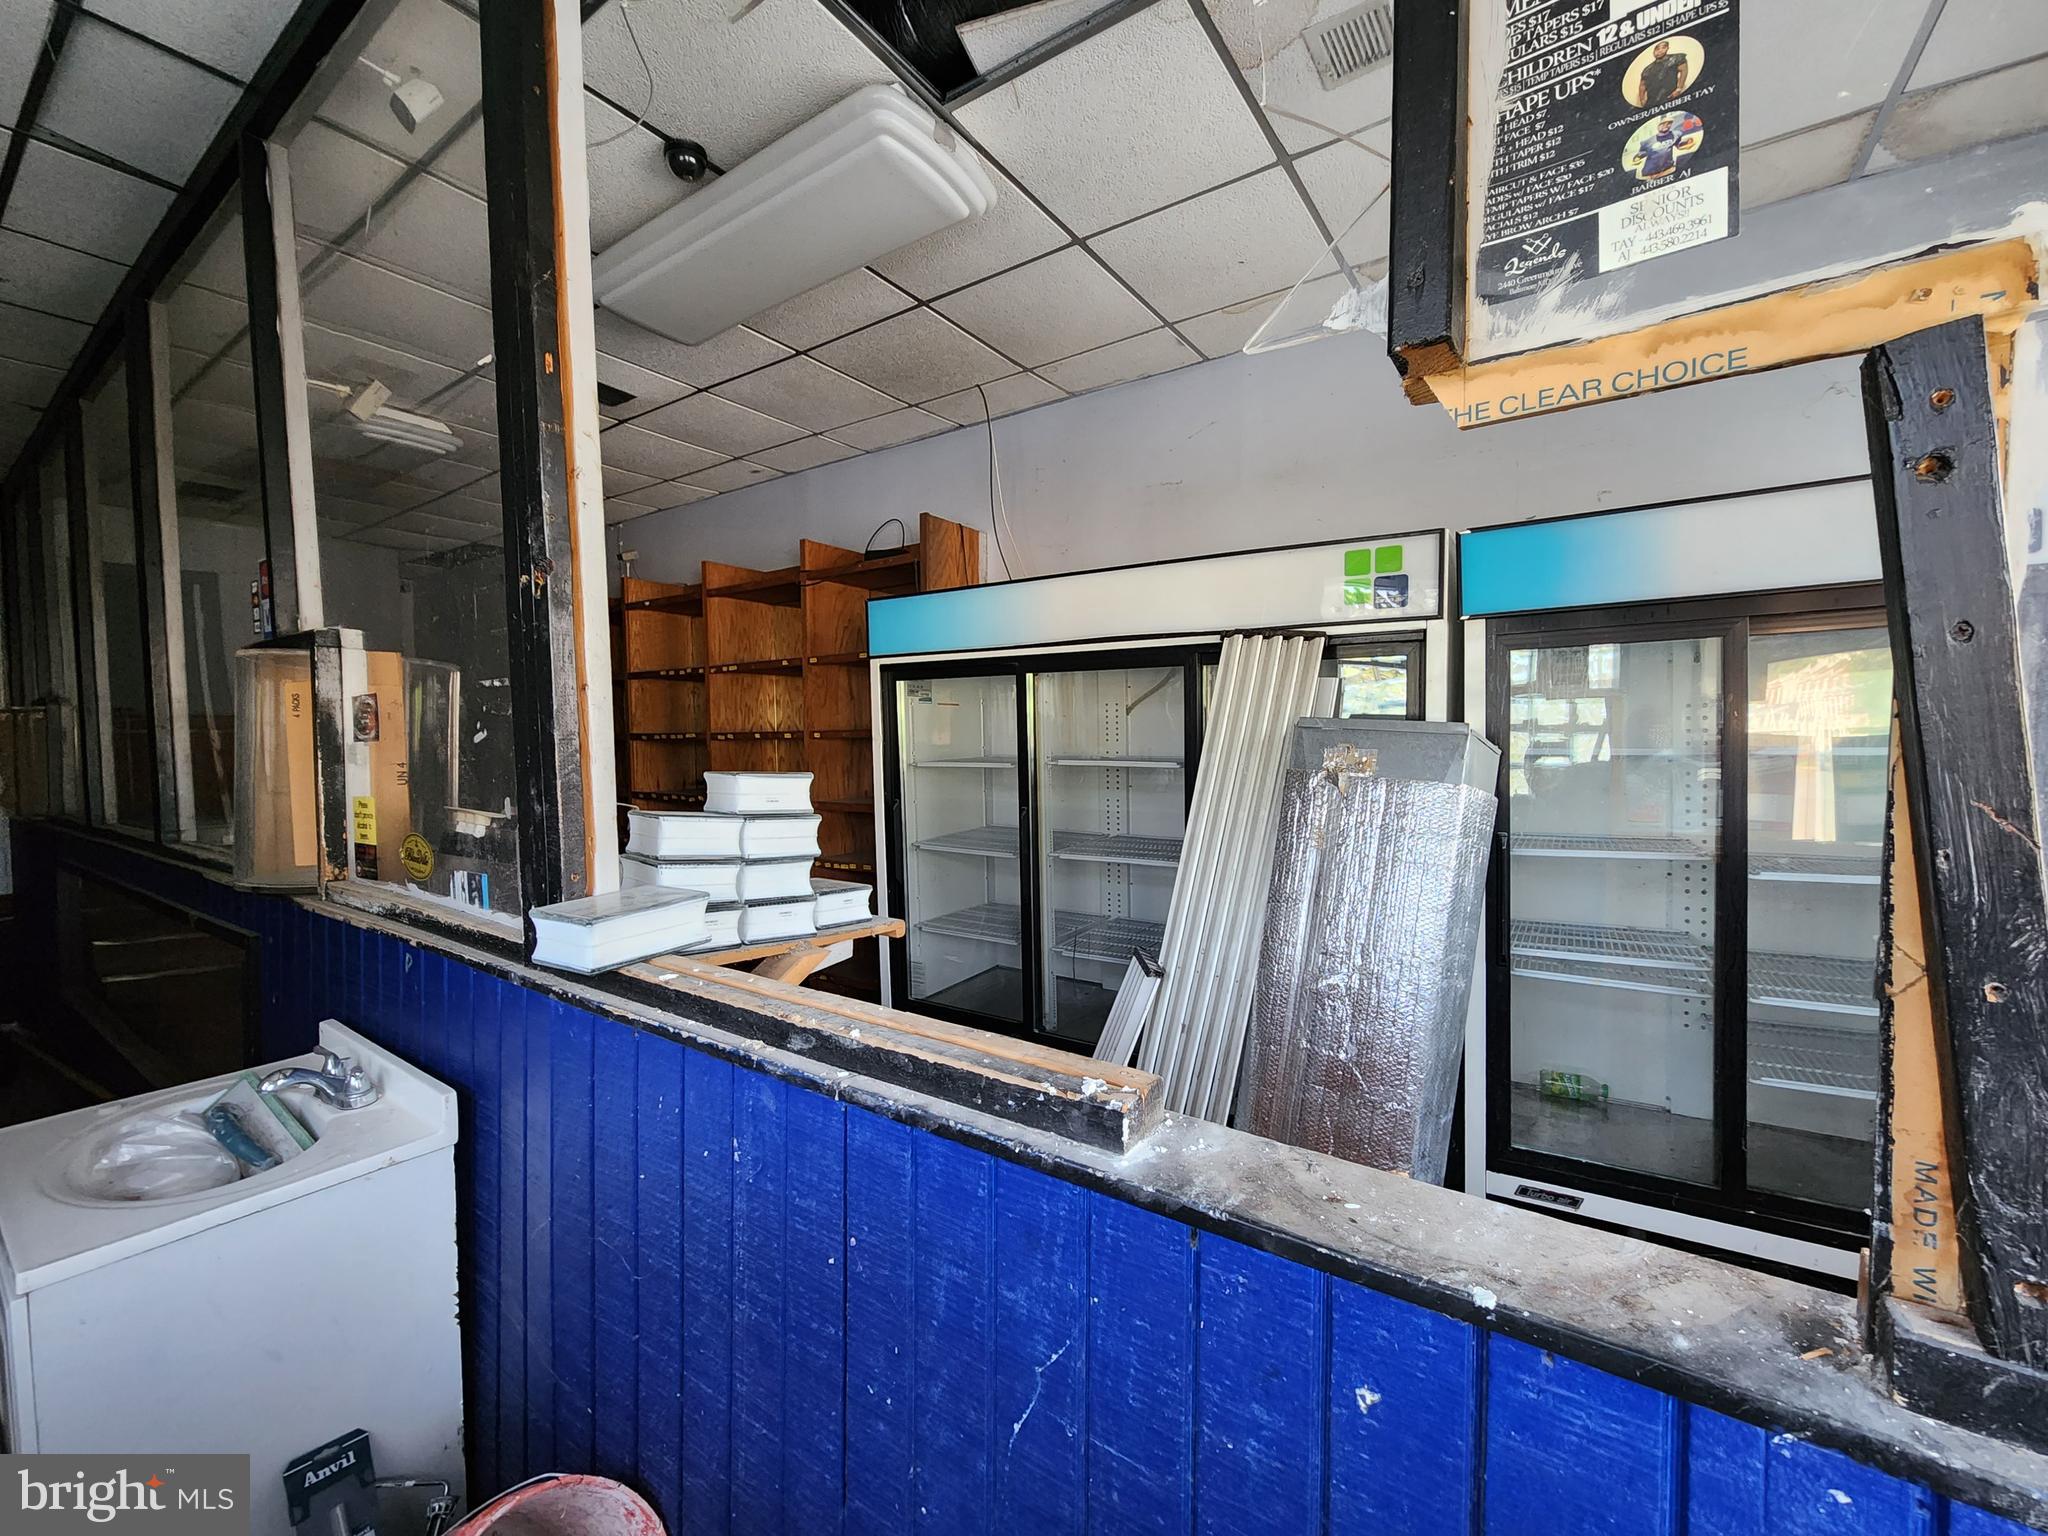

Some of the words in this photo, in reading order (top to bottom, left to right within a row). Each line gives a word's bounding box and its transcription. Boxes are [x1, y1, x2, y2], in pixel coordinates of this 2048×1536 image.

[1523, 7, 1580, 42] TAPERS
[1528, 8, 1551, 27] $17
[1560, 20, 1584, 39] $15
[1596, 24, 1619, 48] 12
[1619, 20, 1636, 38] &
[1525, 71, 1550, 87] TEMP
[1550, 56, 1581, 77] TAPERS
[1599, 31, 1647, 58] REGULARS
[1666, 8, 1698, 30] SHAPE
[1698, 2, 1718, 17] UPS
[1692, 84, 1716, 99] TAY
[1503, 113, 1535, 132] HEAD
[1504, 125, 1532, 143] FACE
[1515, 131, 1547, 149] HEAD
[1547, 124, 1565, 137] $12
[1509, 142, 1544, 161] TAPER
[1545, 136, 1562, 149] $12
[1509, 154, 1538, 172] TRIM
[1539, 150, 1556, 162] $12
[1578, 183, 1596, 195] $17
[1501, 223, 1534, 237] BROW
[1534, 211, 1567, 228] ARCH
[1523, 211, 1539, 222] $12
[1610, 234, 1637, 253] TAY
[1503, 241, 1568, 277] Legends
[1499, 378, 1604, 415] CLEAR
[1611, 347, 1749, 393] CHOICE
[290, 692, 301, 712] PACKS
[1525, 1187, 1556, 1201] Turbo
[303, 1450, 357, 1488] Anvil
